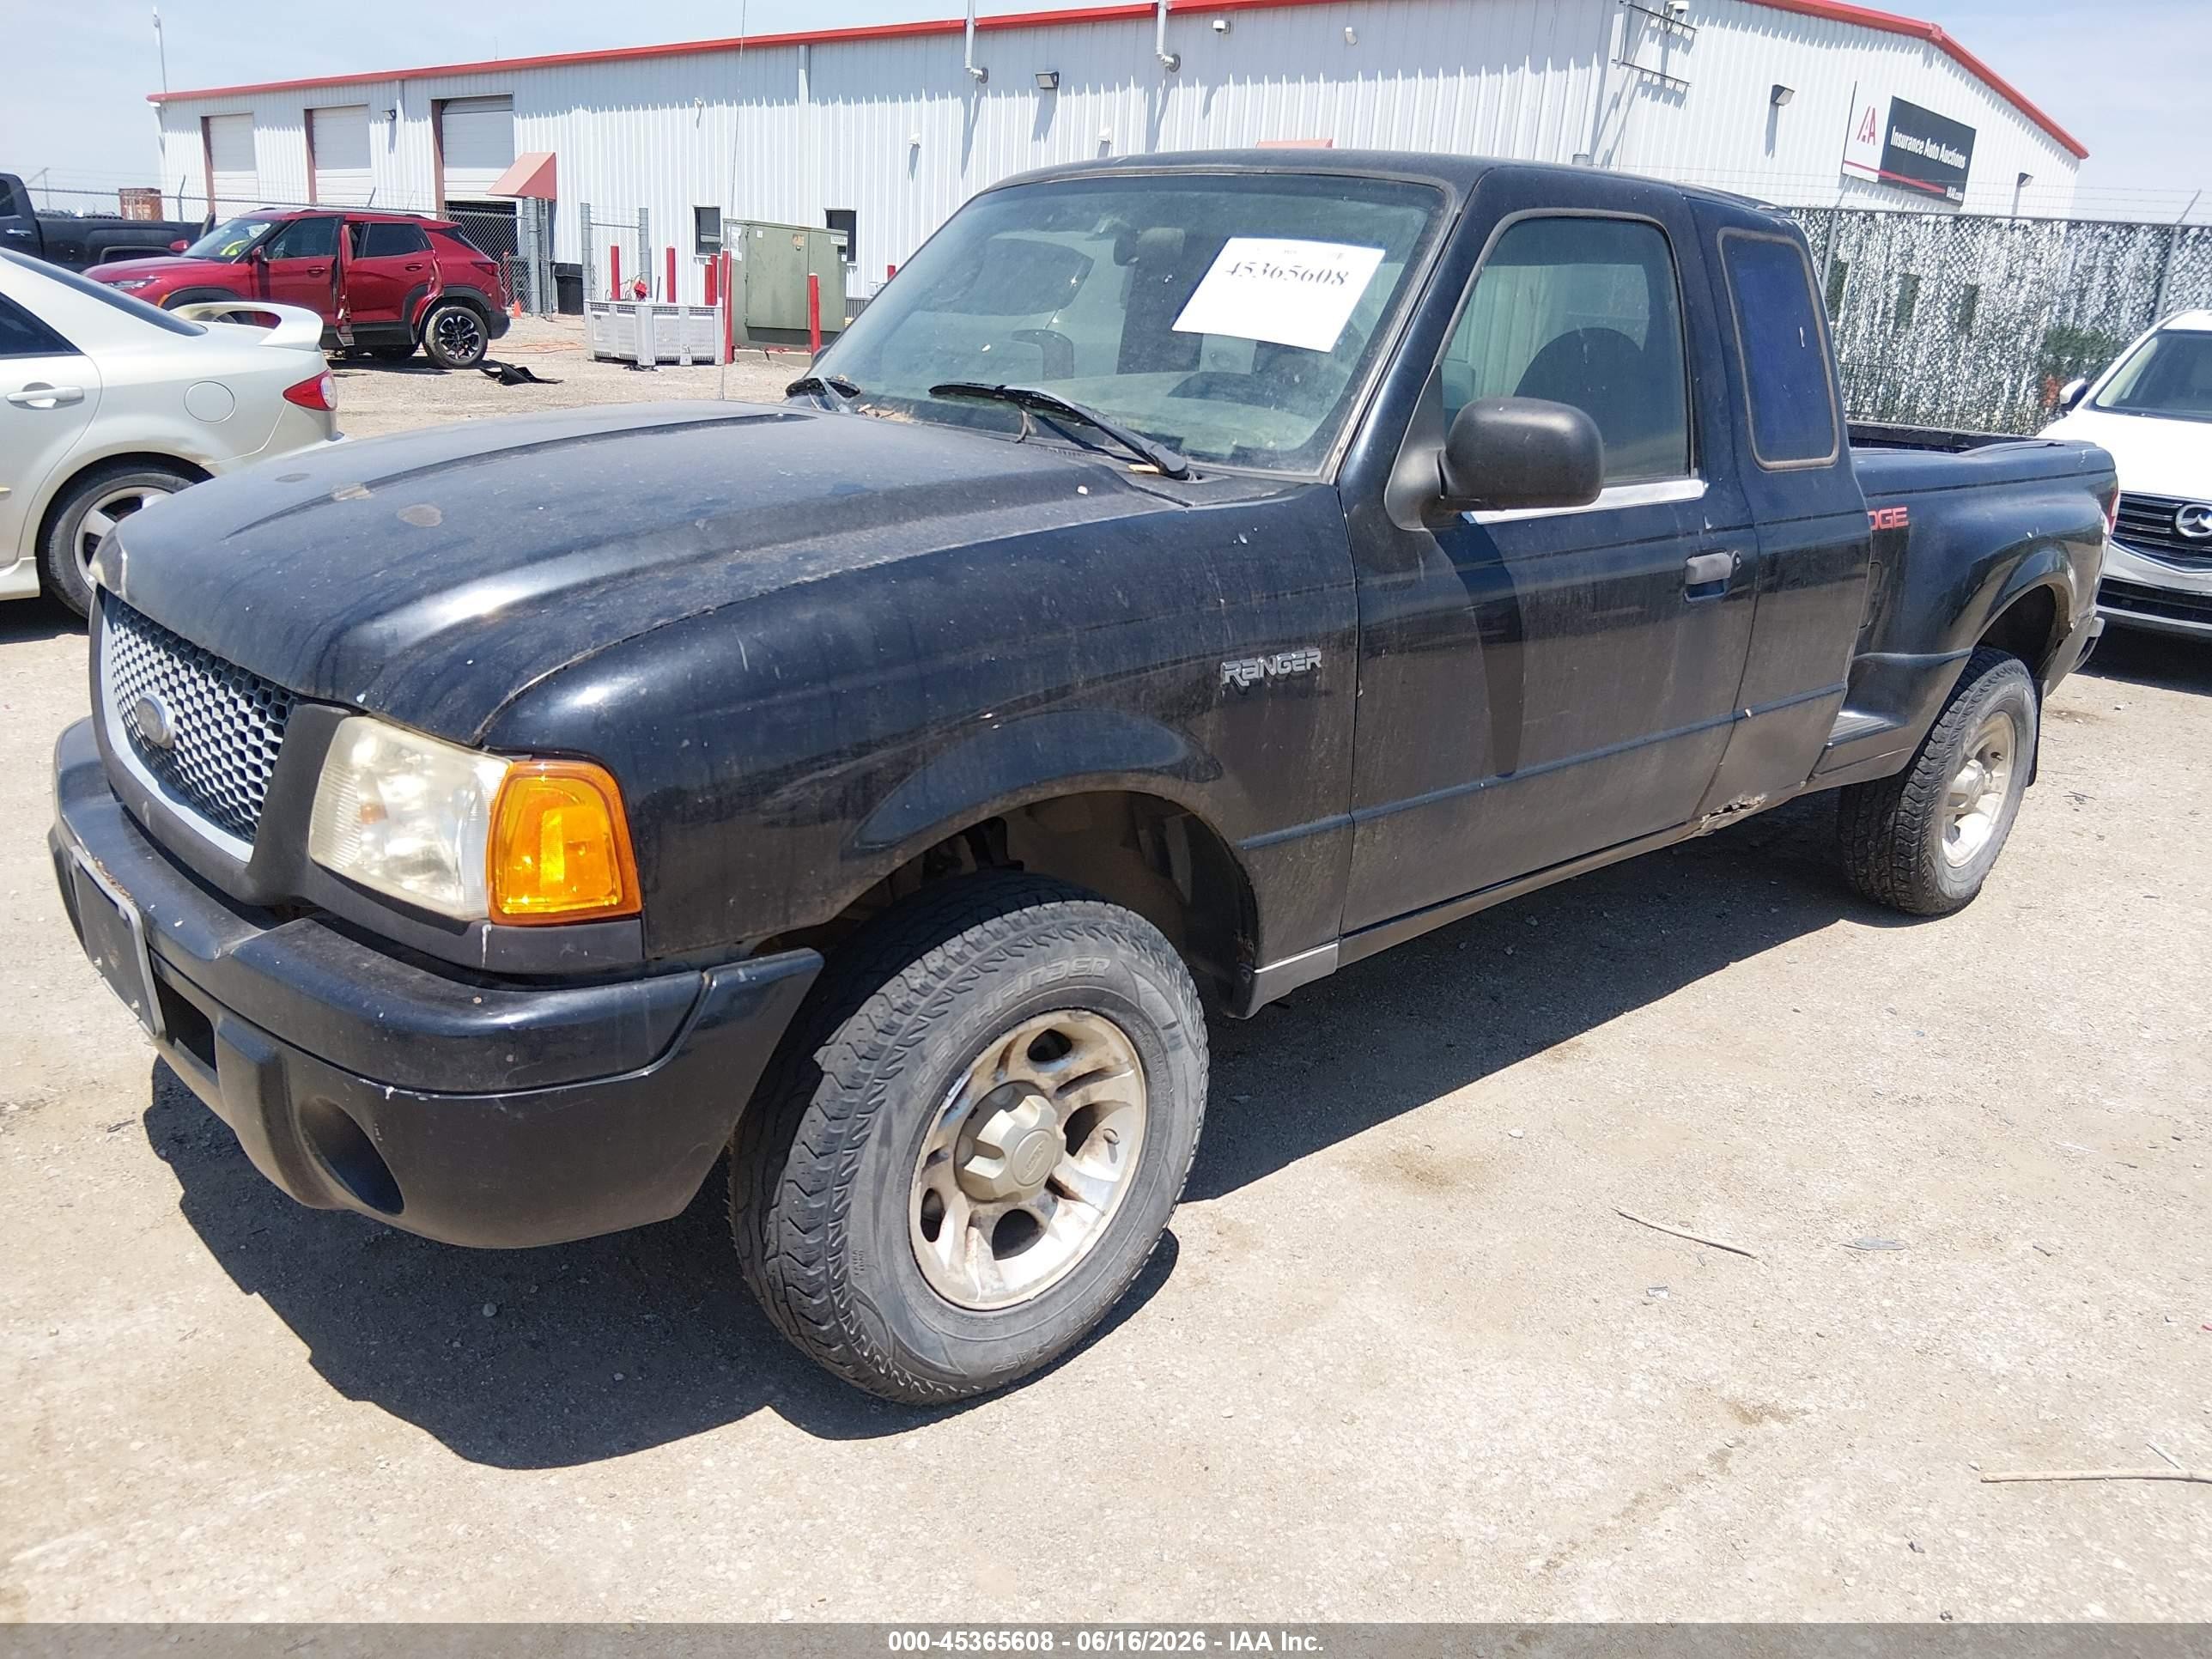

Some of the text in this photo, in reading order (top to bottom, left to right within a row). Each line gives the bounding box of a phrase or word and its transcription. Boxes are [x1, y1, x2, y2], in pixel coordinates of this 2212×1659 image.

[1890, 125, 1966, 170] Insurance Auto Auctions
[1225, 260, 1350, 286] 45365608
[1220, 648, 1322, 686] RANGER
[912, 954, 1111, 1100] PATHFINDER
